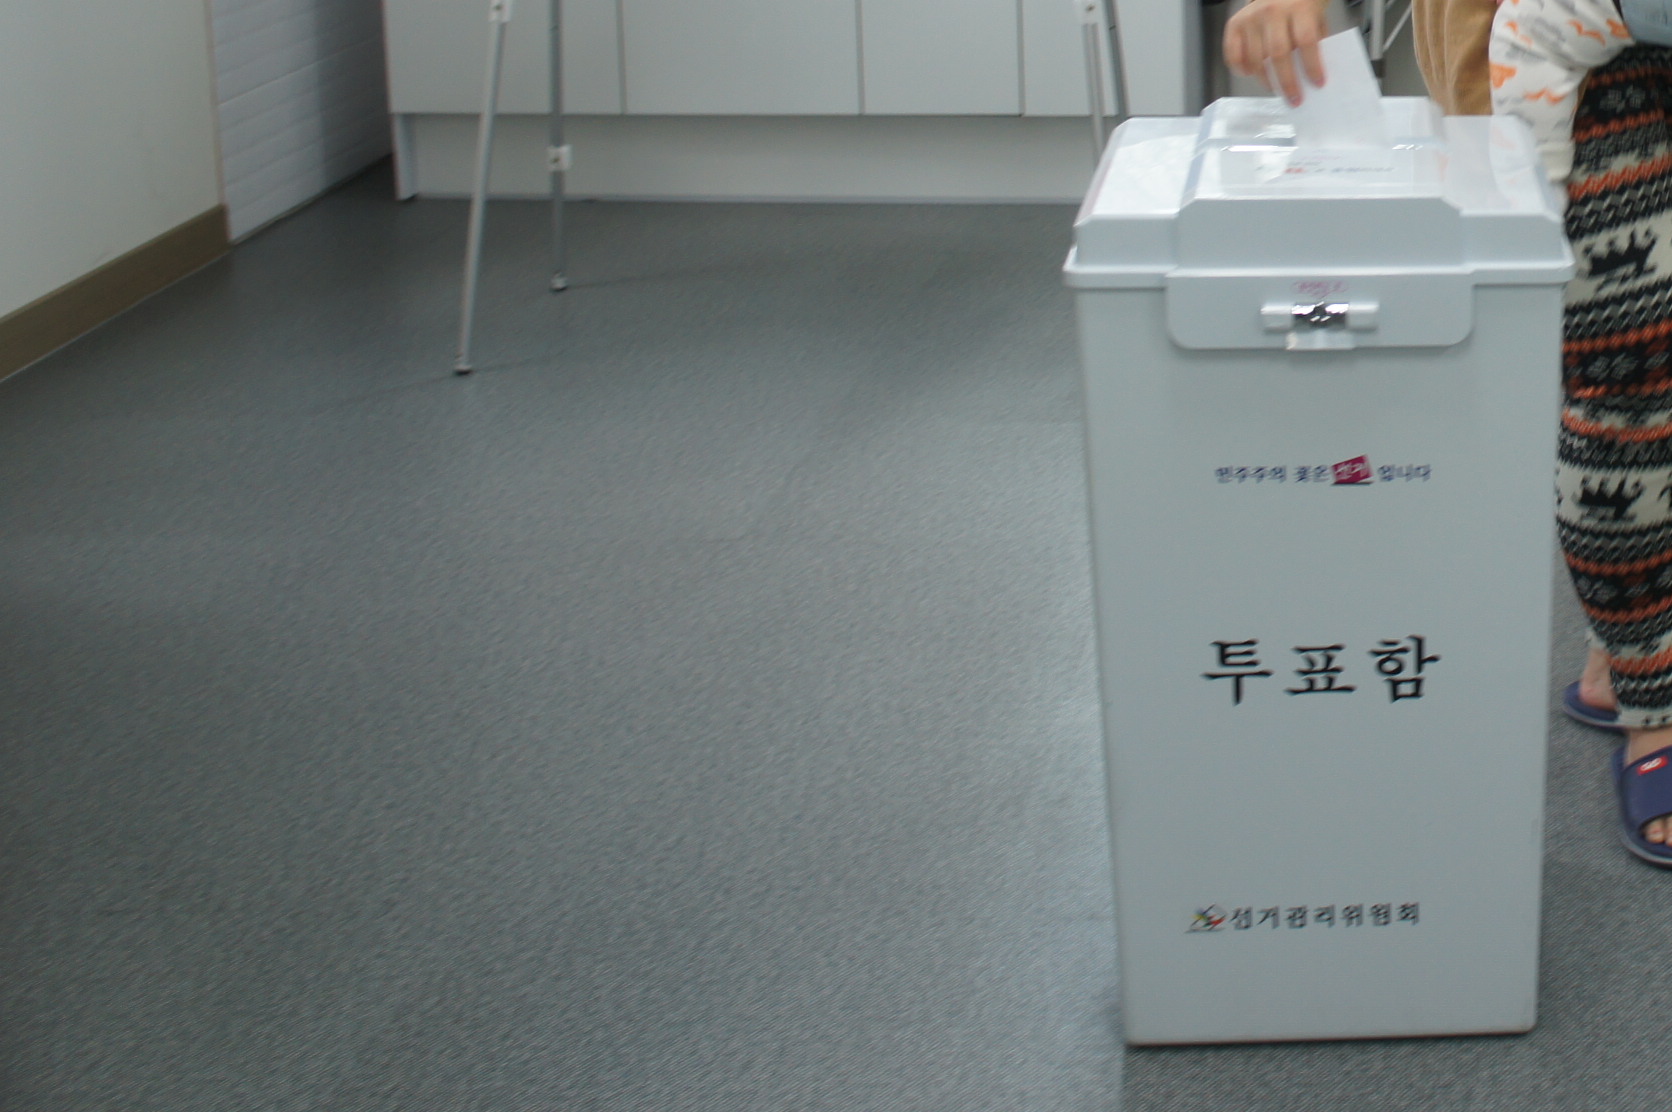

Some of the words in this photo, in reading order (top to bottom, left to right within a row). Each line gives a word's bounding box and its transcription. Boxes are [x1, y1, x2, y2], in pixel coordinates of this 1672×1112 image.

[1215, 465, 1287, 485] 민주주의
[1377, 464, 1433, 483] 입니다
[1201, 634, 1442, 707] 투표함
[1230, 901, 1421, 931] 선거관리위원회
